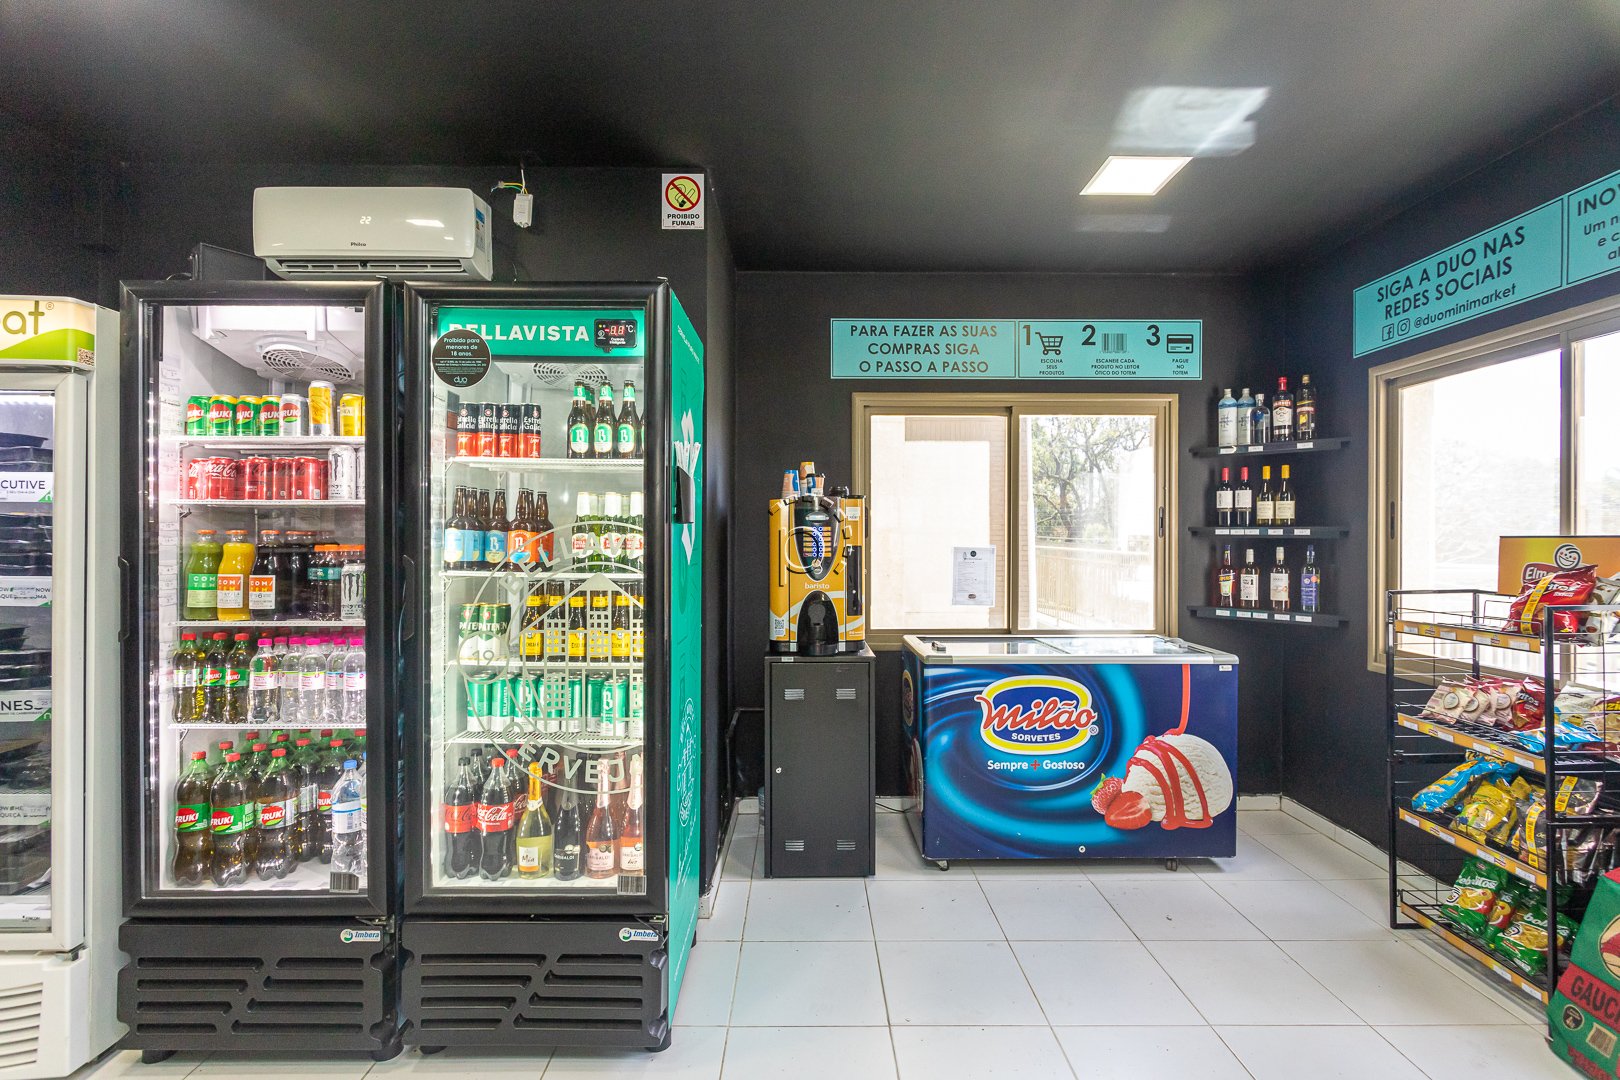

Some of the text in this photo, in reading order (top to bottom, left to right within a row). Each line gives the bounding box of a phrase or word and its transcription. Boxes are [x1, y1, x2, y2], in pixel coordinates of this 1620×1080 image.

[360, 216, 372, 224] 22
[1584, 220, 1606, 236] Um
[1597, 237, 1607, 247] e
[1377, 226, 1526, 303] SIGA A DUO NAS
[1384, 256, 1513, 320] REDES SOCIAIS
[1413, 283, 1517, 329] @duominimarket
[850, 325, 998, 337] PARA FAZER AS SUAS
[1022, 324, 1031, 346] 1
[1081, 324, 1097, 346] 2
[1146, 324, 1161, 347] 3
[867, 342, 980, 355] COMPRAS SIGA
[859, 360, 989, 373] O PASSO A PASSO
[598, 429, 607, 442] B
[620, 429, 629, 442] B
[490, 536, 499, 551] B
[804, 582, 831, 590] baristo
[0, 700, 43, 711] NES
[1011, 732, 1061, 742] SORVETES
[987, 760, 1029, 772] Sempre
[1042, 760, 1086, 771] Gostoso
[175, 812, 199, 823] FRUKI
[211, 815, 234, 826] FRUKI
[260, 809, 285, 821] FRUKI
